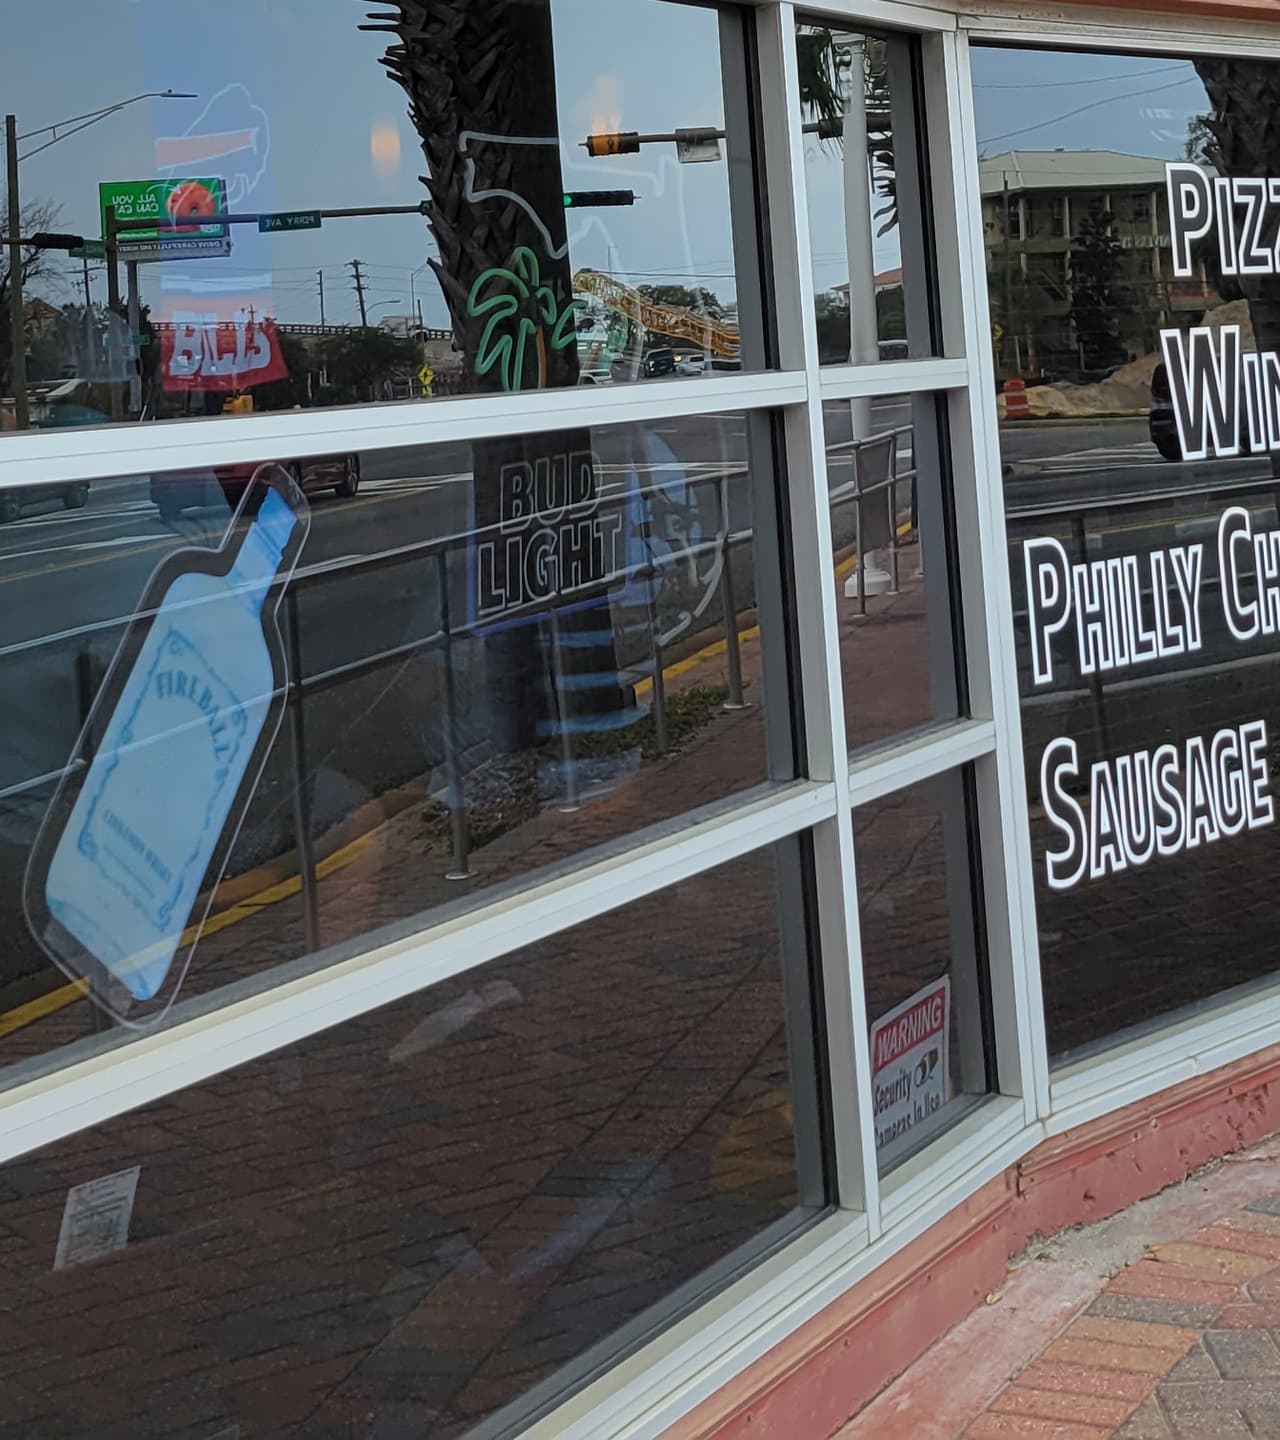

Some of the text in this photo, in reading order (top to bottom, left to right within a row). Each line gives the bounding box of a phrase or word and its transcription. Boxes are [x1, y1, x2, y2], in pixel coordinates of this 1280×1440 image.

[500, 450, 603, 535] BUD
[478, 512, 622, 616] LIGHT
[1023, 536, 1203, 685] PHILLY
[1040, 718, 1274, 890] SAUSAGE
[877, 996, 942, 1064] WARNING
[874, 1067, 913, 1117] Security
